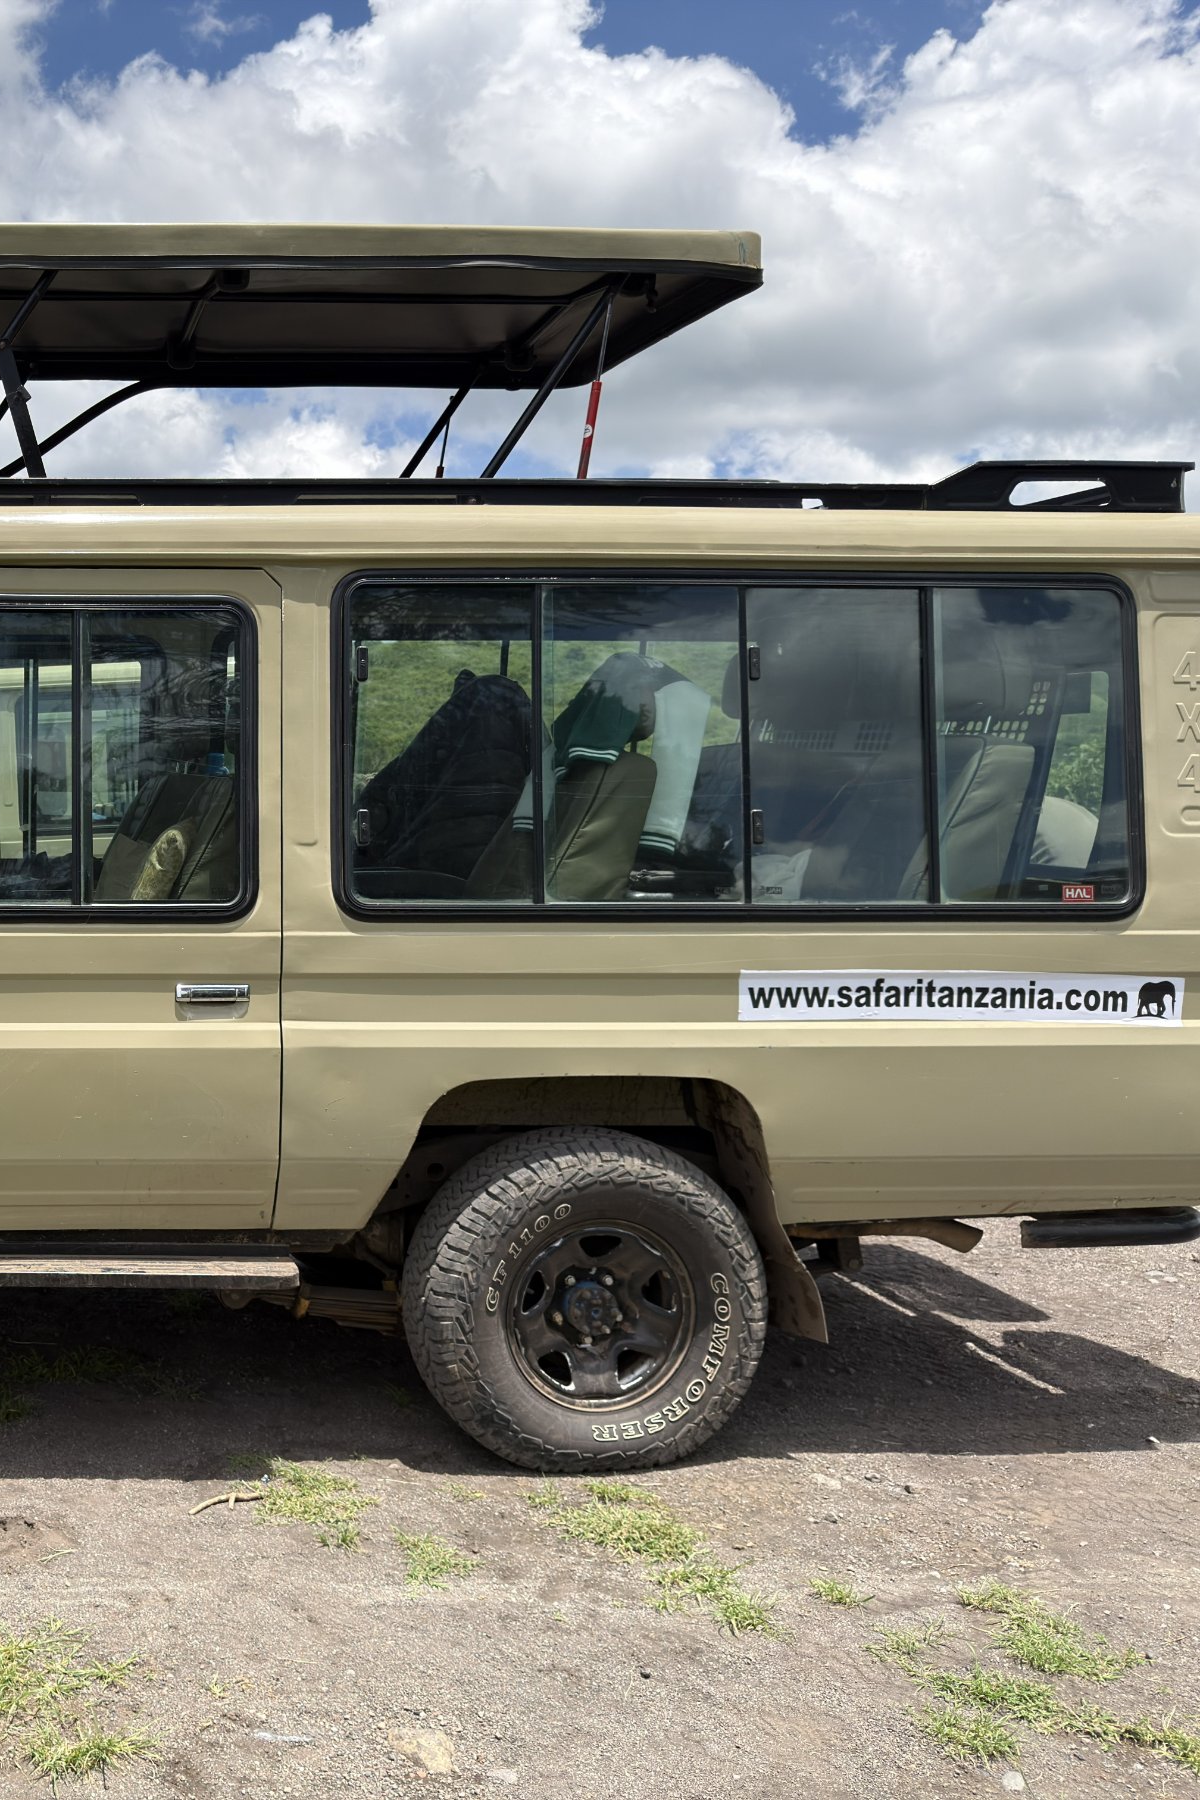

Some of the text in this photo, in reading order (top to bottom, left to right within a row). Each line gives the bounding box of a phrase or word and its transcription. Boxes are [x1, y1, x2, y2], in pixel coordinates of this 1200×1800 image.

[1065, 888, 1091, 898] HAL
[748, 978, 1128, 1012] www.safaritanzania.com
[485, 1203, 572, 1312] CF 1100
[591, 1272, 732, 1442] COMFORSER
